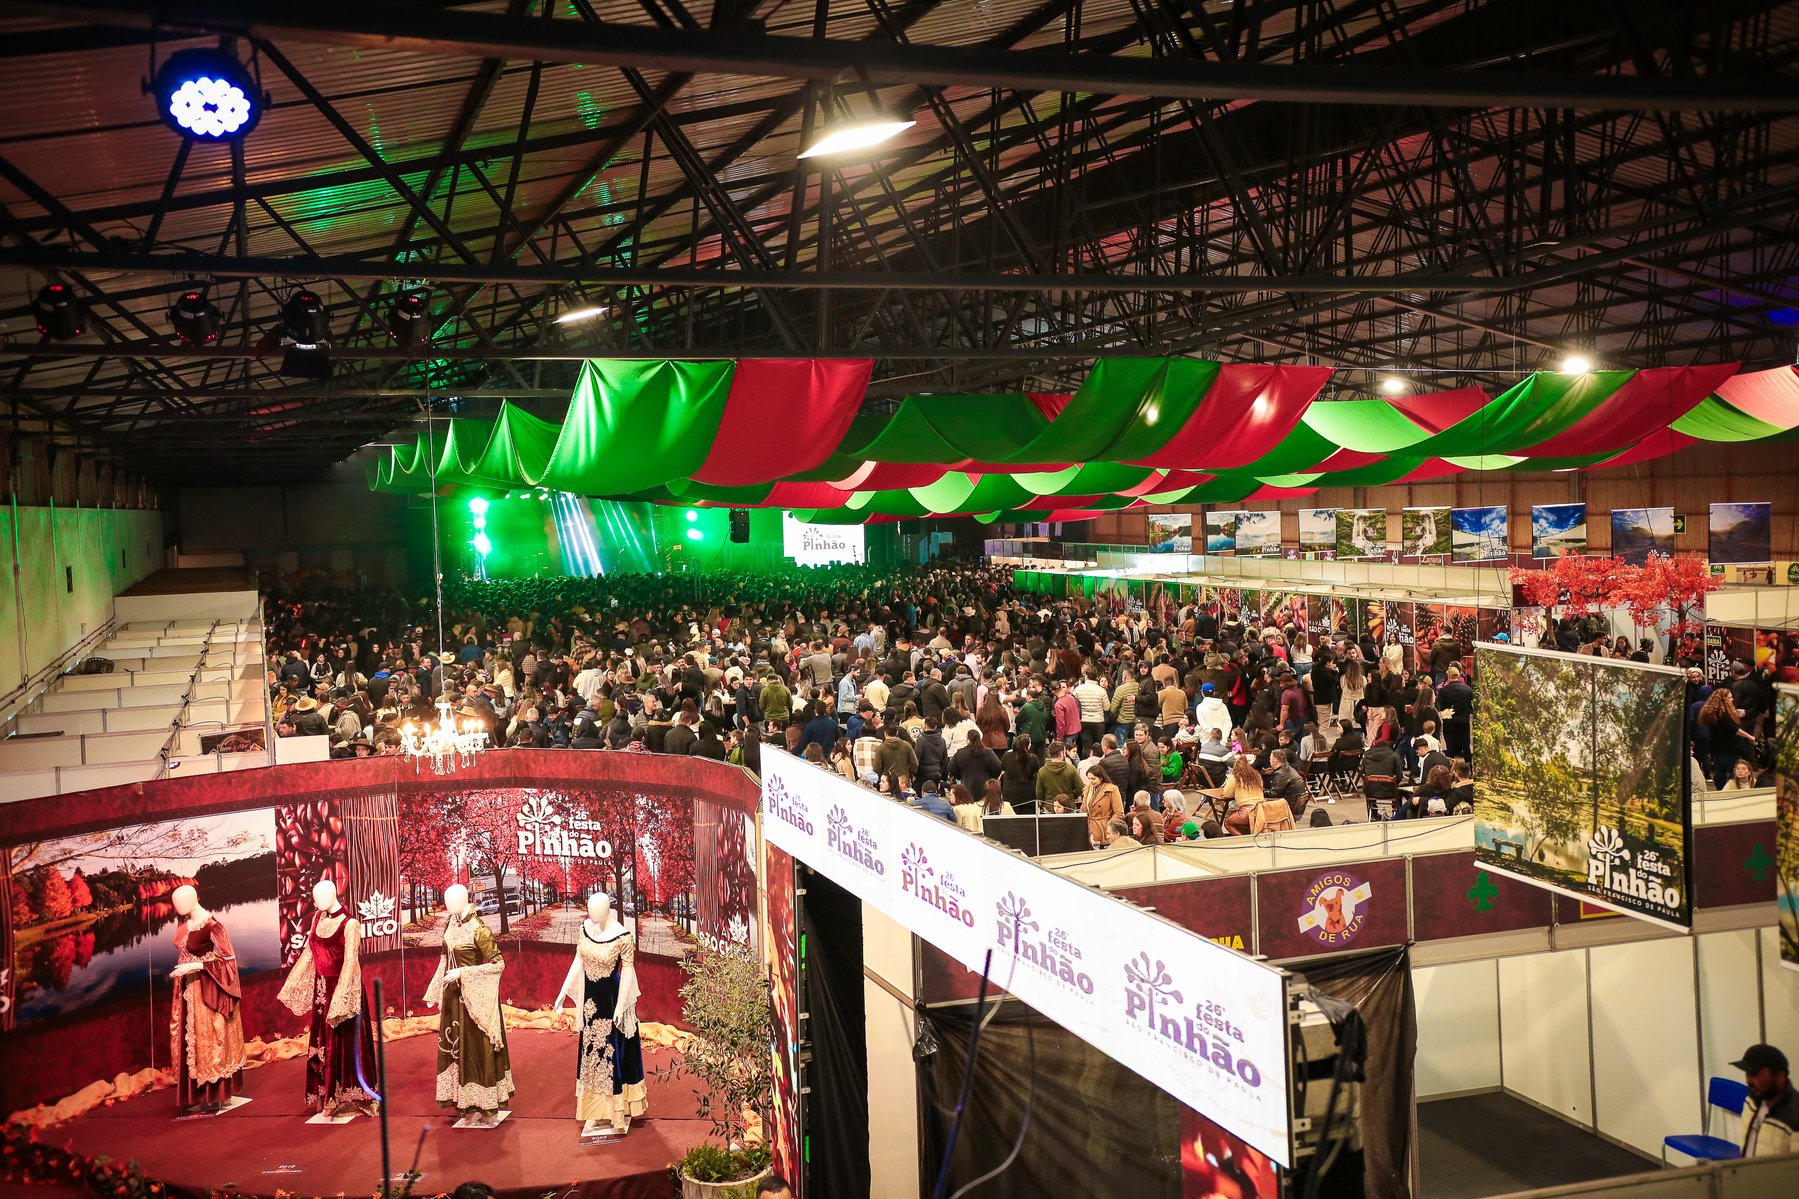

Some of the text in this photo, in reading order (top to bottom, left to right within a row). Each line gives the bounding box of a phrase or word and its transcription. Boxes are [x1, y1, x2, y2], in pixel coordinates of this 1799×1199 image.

[569, 816, 601, 831] festa
[768, 794, 814, 836] Pinhão
[517, 824, 612, 858] Pinhão
[569, 830, 579, 838] do
[857, 830, 878, 850] festa
[535, 856, 574, 864] FRANCIO
[827, 827, 885, 876] Pinhão
[1637, 854, 1671, 877] festa
[940, 874, 966, 898] festa
[1588, 856, 1680, 909] Pinhão
[1637, 870, 1648, 879] do
[902, 868, 975, 928] Pinhão
[1307, 875, 1352, 905] AMIGOS
[1588, 885, 1681, 918] SÃO FRANCISCO DE PAULA
[360, 919, 398, 940] ICO
[1318, 914, 1364, 943] DE RUA
[997, 919, 1094, 995] Pinhão
[1047, 930, 1083, 960] festa
[1125, 986, 1261, 1088] Pinhão
[1196, 1003, 1245, 1043] festa
